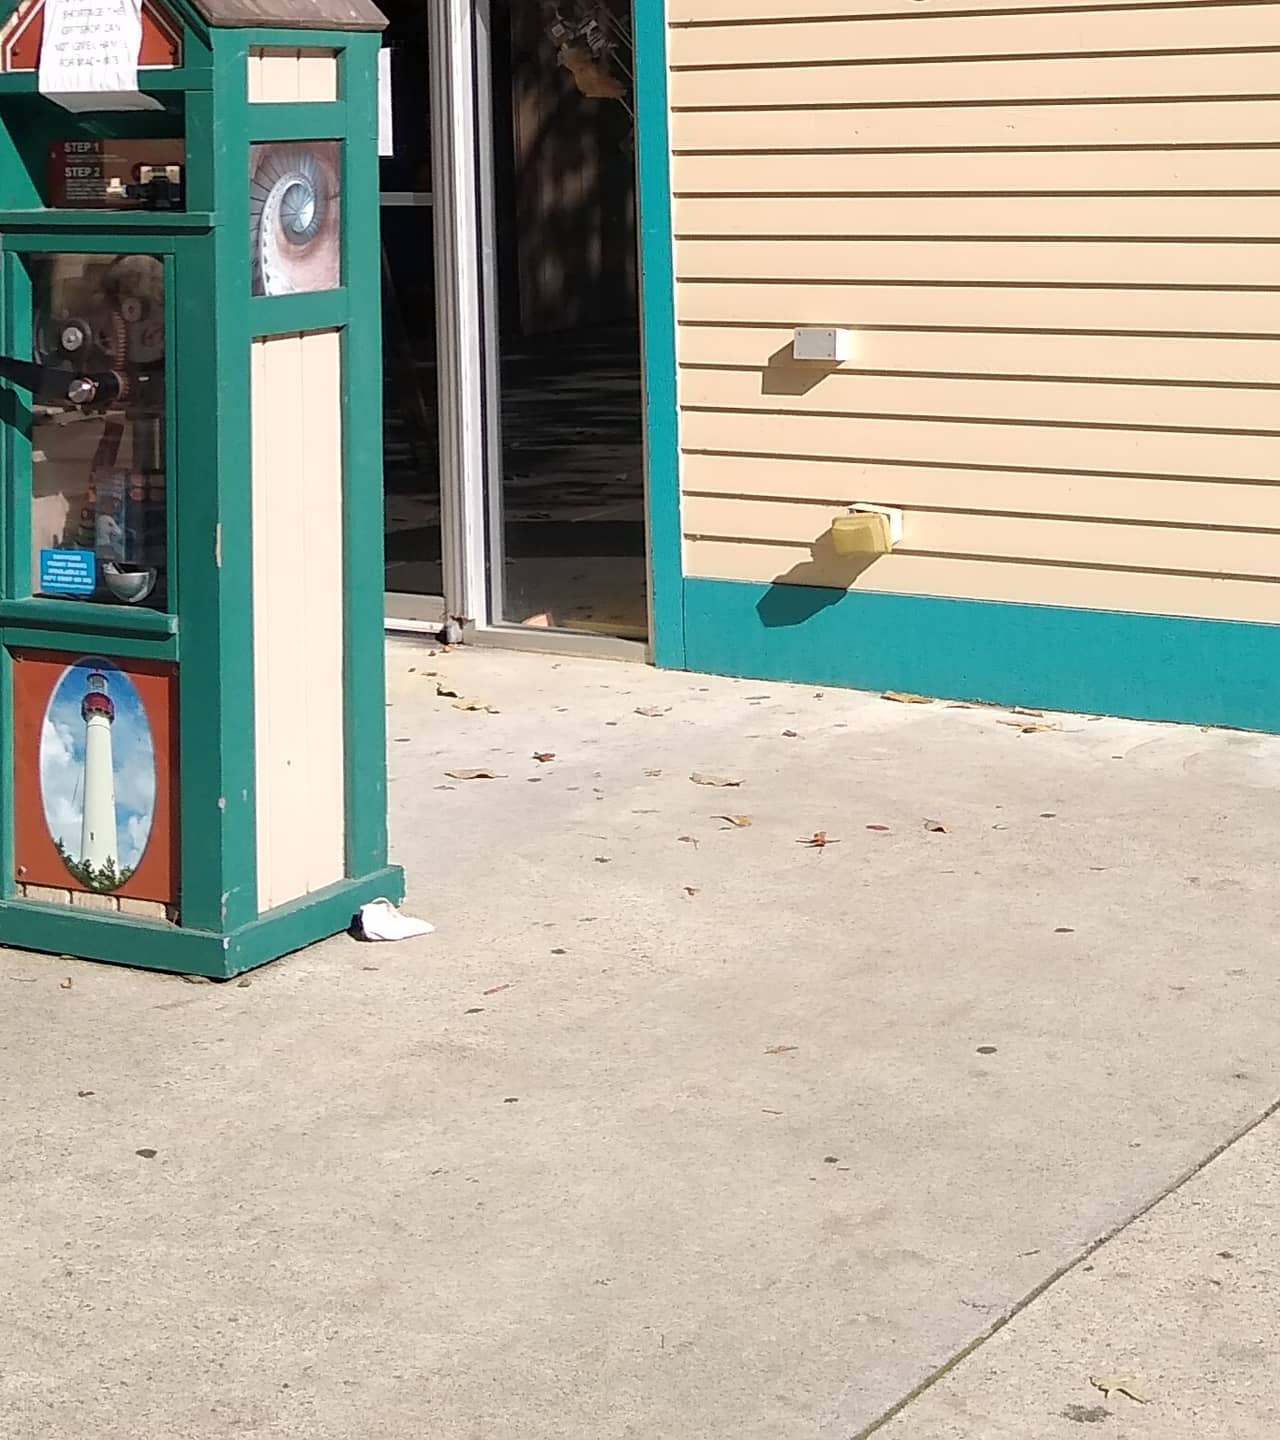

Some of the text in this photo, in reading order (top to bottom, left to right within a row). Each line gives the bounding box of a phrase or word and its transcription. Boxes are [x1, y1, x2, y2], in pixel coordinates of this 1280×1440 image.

[64, 142, 91, 153] STEP
[64, 166, 101, 178] STEP 2
